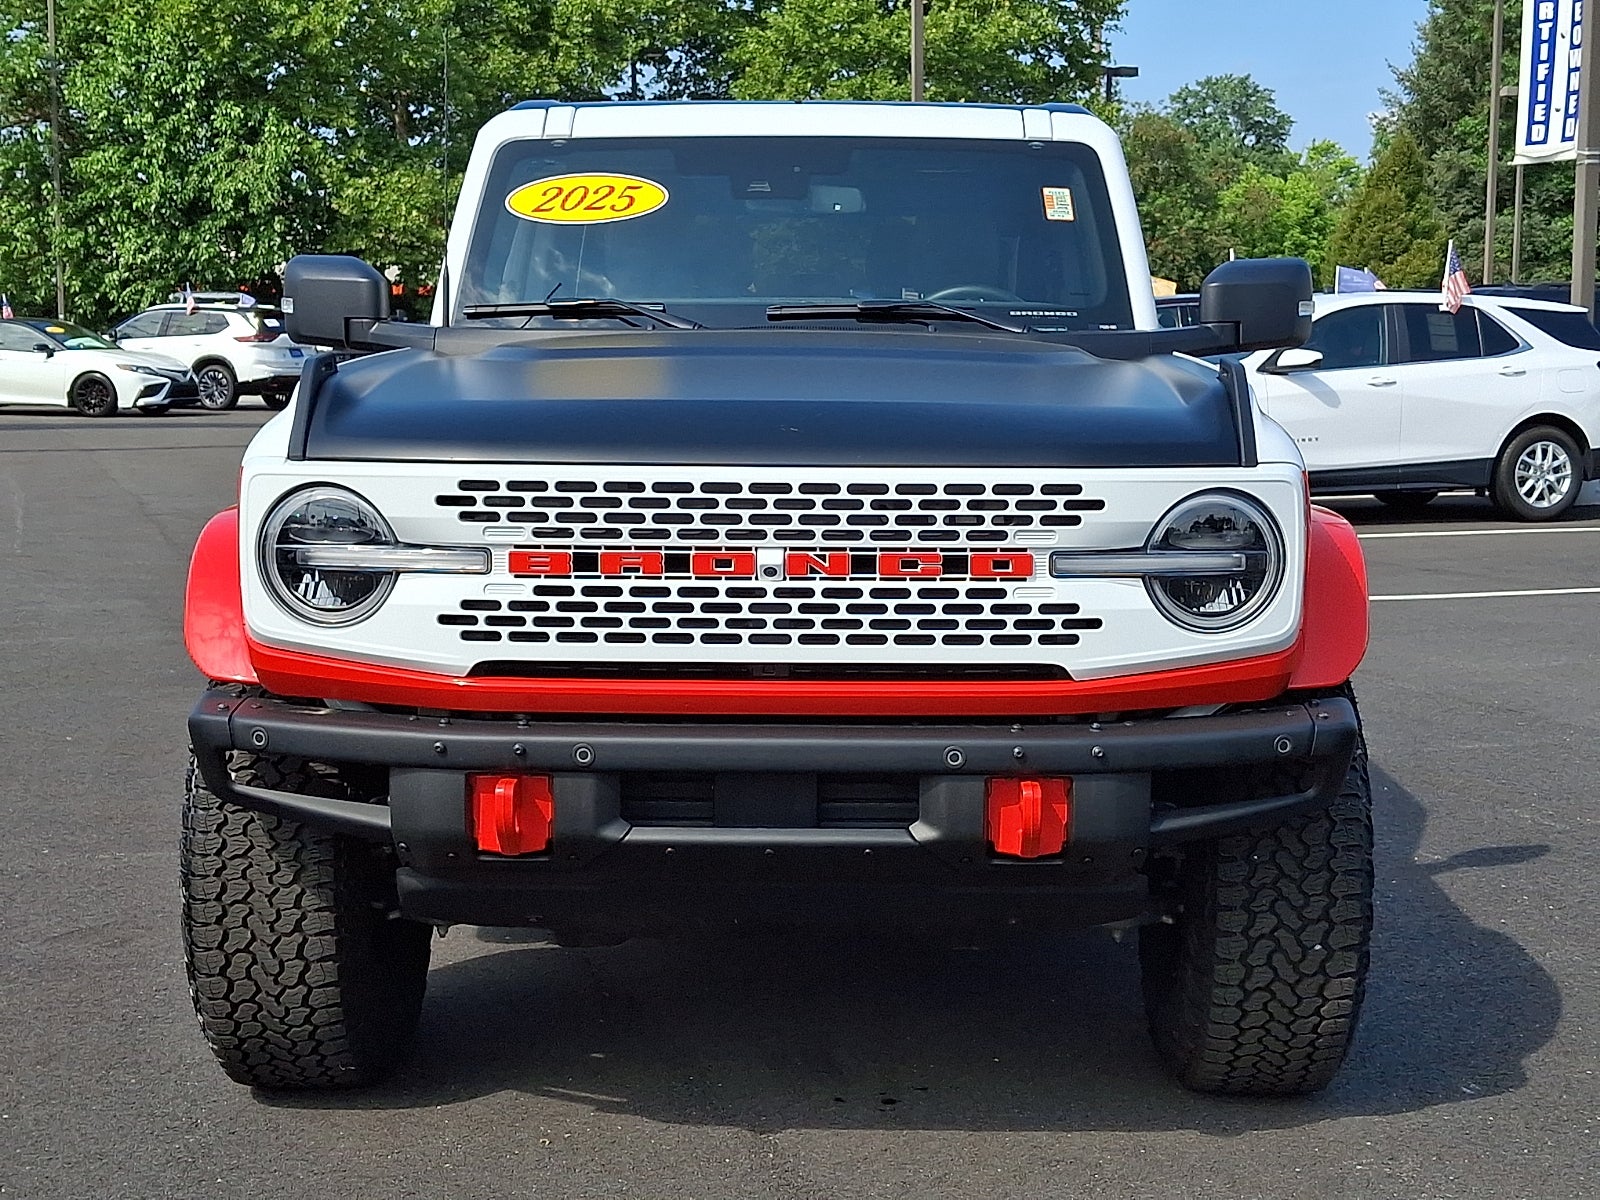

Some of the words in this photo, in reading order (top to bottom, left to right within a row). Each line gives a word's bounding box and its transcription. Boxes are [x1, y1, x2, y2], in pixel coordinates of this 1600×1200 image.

[1530, 1, 1555, 142] RTIFIED
[531, 185, 643, 213] 2025
[508, 550, 1034, 577] BRONCO
